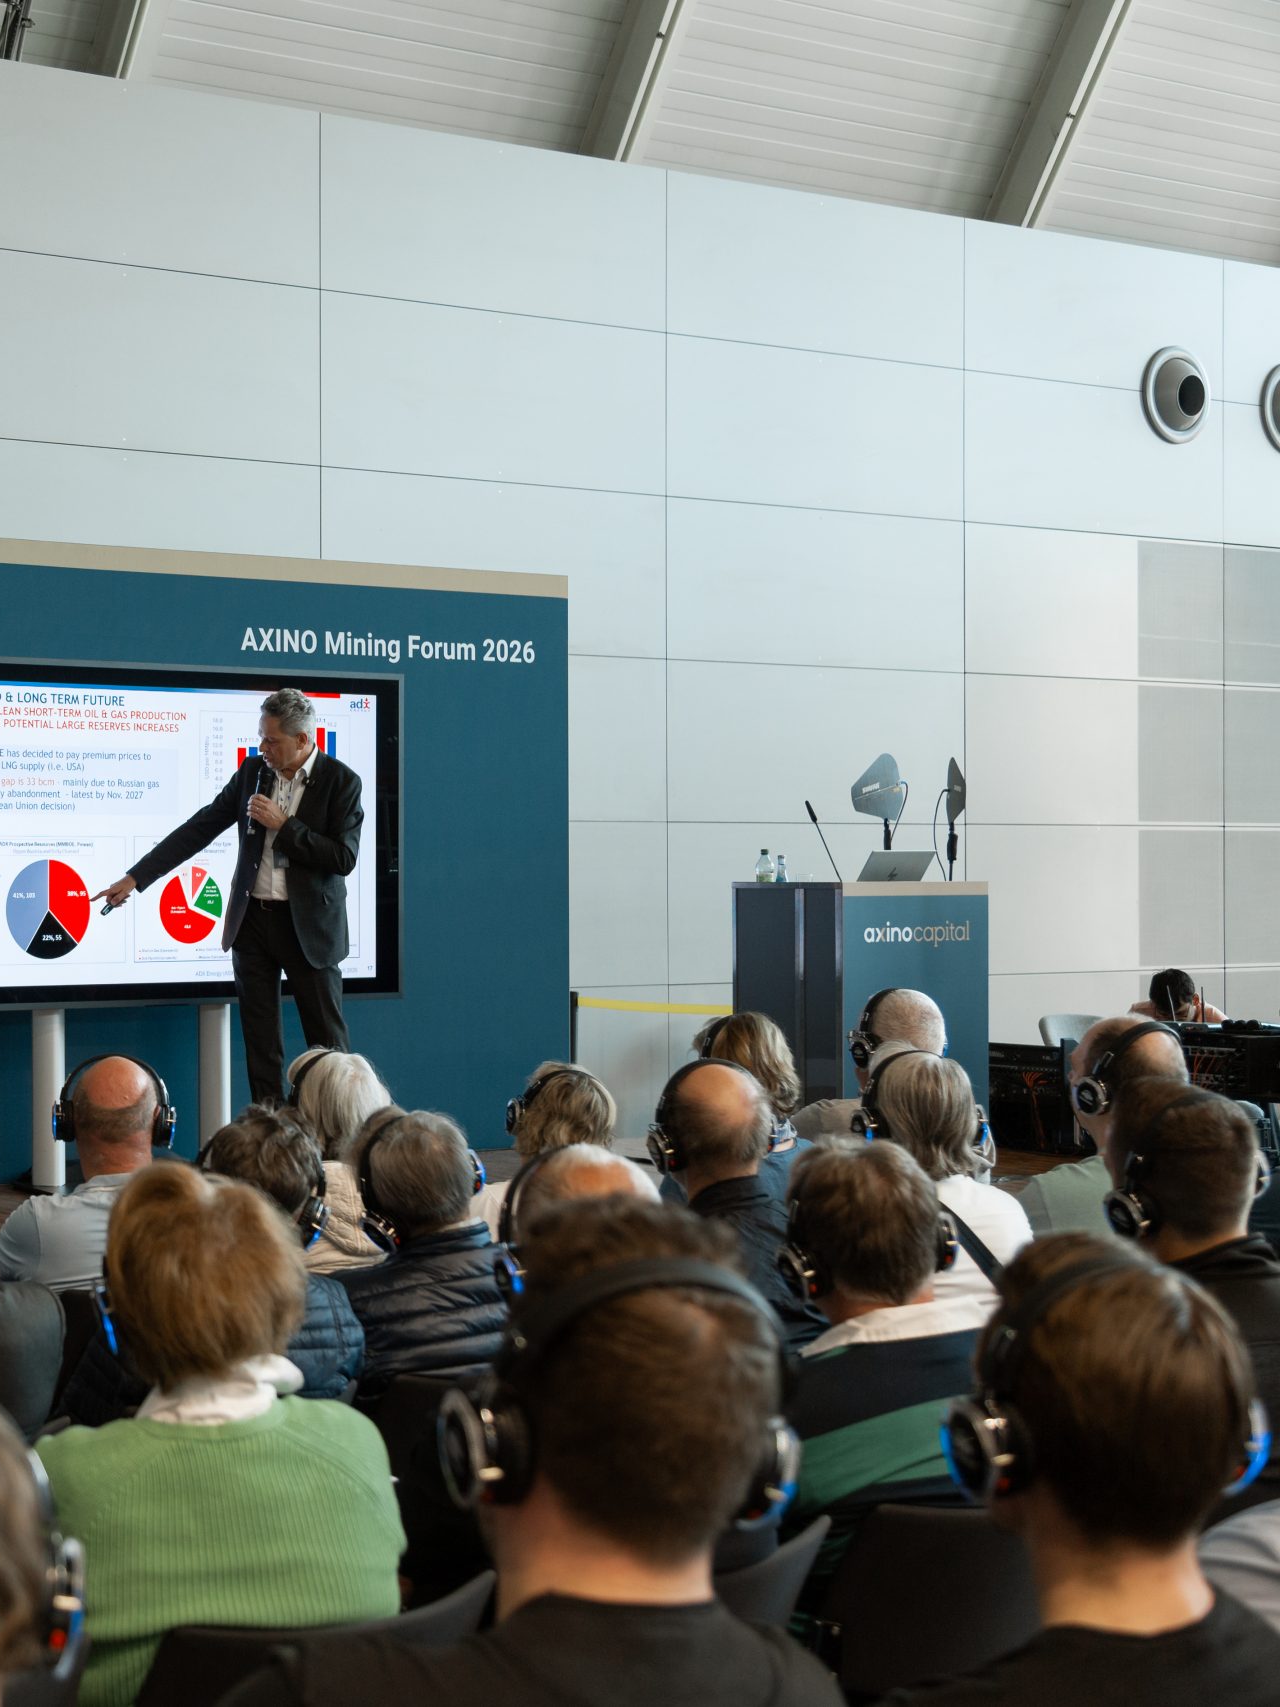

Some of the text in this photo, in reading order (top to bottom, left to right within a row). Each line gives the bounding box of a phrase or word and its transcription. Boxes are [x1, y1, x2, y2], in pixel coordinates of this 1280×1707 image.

[240, 627, 536, 664] AXINO Mining Forum 2026
[5, 692, 13, 703] &
[17, 692, 48, 704] LONG
[51, 693, 80, 705] TERM
[83, 694, 125, 706] FUTURE
[24, 707, 81, 718] SHORT-TERM
[84, 709, 99, 718] OIL
[101, 710, 108, 719] &
[110, 710, 128, 719] GAS
[130, 711, 187, 721] PRODUCTION
[3, 719, 54, 729] POTENTIAL
[56, 720, 85, 730] LARGE
[88, 721, 131, 731] RESERVES
[133, 723, 179, 733] INCREASES
[6, 748, 20, 758] has
[22, 749, 53, 759] decided
[55, 751, 64, 759] to
[66, 752, 80, 761] pay
[82, 751, 117, 761] premium
[118, 752, 141, 762] prices
[143, 752, 152, 761] to
[1, 761, 18, 770] LNG
[19, 761, 45, 772] supply
[66, 762, 85, 772] USA)
[1, 778, 16, 788] gap
[18, 777, 24, 786] is
[26, 777, 36, 786] 33
[38, 777, 55, 786] bcm
[62, 778, 89, 789] mainly
[90, 779, 106, 788] due
[107, 779, 116, 788] to
[117, 779, 145, 788] Russian
[147, 780, 160, 790] gas
[7, 789, 61, 798] abandonment
[71, 790, 93, 799] latest
[95, 790, 105, 800] by
[107, 791, 123, 800] Nov.
[125, 790, 144, 800] 2027
[15, 801, 39, 810] Union
[40, 801, 76, 812] decision)
